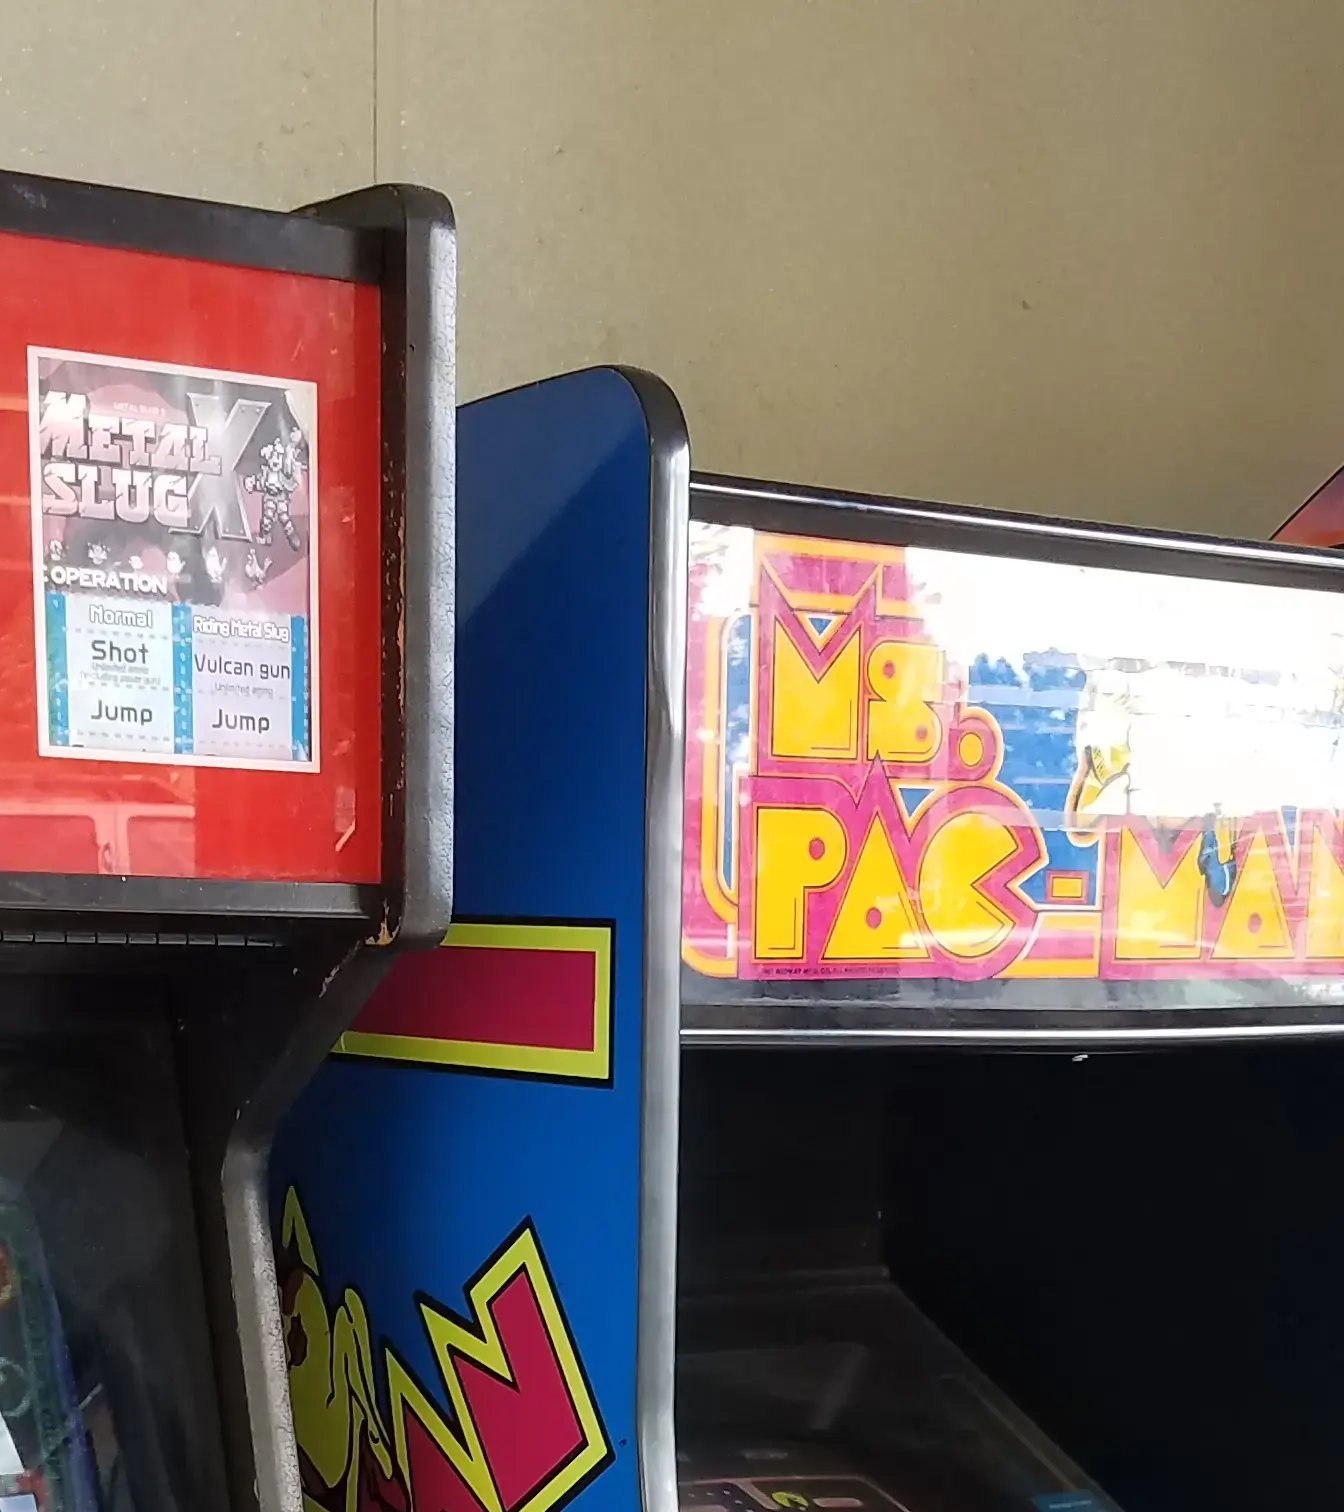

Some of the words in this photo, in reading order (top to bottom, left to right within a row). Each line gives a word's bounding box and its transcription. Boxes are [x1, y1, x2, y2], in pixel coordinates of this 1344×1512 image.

[40, 390, 221, 475] METAL
[43, 461, 189, 528] SLUG
[50, 565, 169, 595] OPERATION
[88, 603, 154, 629] Normal
[192, 615, 230, 638] Riding
[230, 620, 262, 639] Metal
[263, 622, 291, 643] Slug
[90, 639, 149, 665] Shot
[194, 653, 254, 677] Vulcan
[259, 660, 291, 682] gun
[90, 699, 153, 726] Jump
[211, 708, 271, 734] Jump
